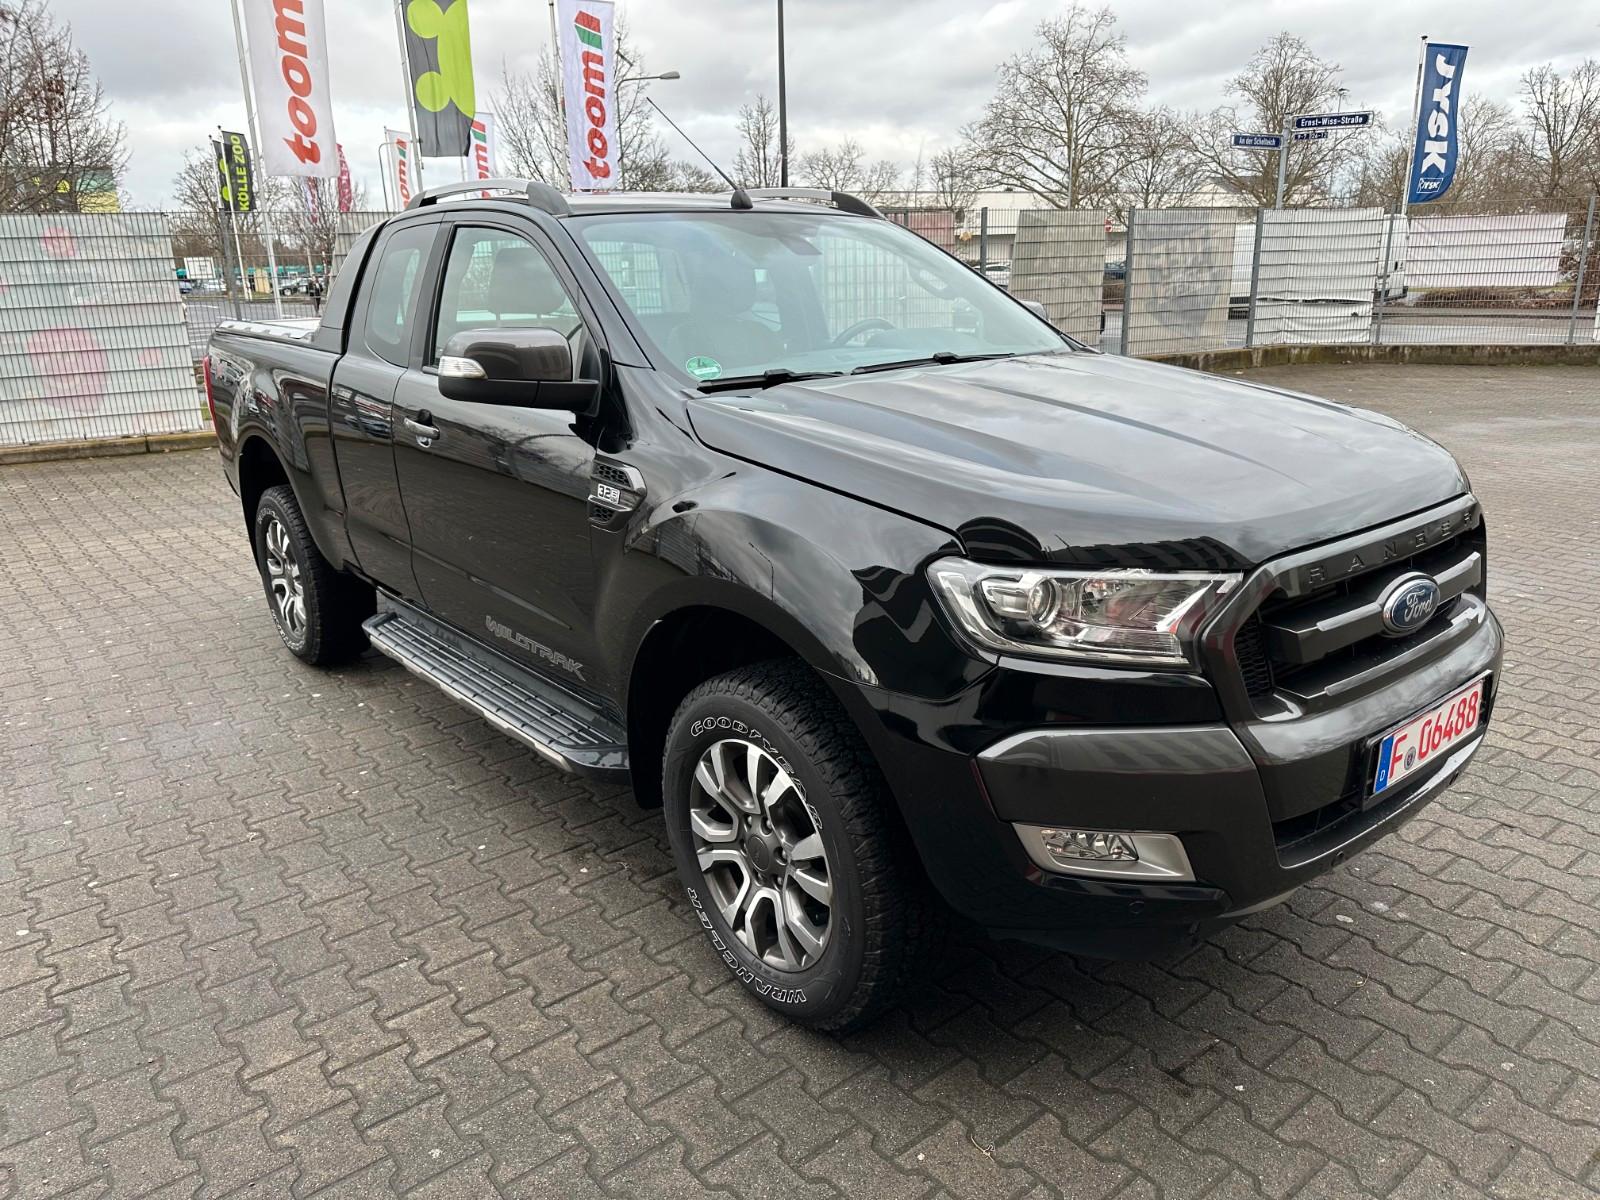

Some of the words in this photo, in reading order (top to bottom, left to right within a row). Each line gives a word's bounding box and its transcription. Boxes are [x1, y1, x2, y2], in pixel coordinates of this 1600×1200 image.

[272, 0, 322, 165] toom
[582, 50, 611, 179] toom
[1420, 53, 1456, 175] JYSK
[230, 134, 246, 165] ZOO
[1239, 136, 1246, 145] An
[1300, 114, 1363, 127] Ernst-Wiss-Straße
[236, 166, 250, 211] KÖLLE
[1308, 510, 1473, 585] RANGER
[1403, 589, 1435, 623] Ford
[485, 615, 586, 682] WILDTRAK
[1388, 733, 1408, 779] F
[1417, 690, 1480, 761] 06488
[690, 716, 823, 830] GOODYEAR
[1379, 769, 1386, 782] D
[687, 887, 807, 1004] WRANGLER
